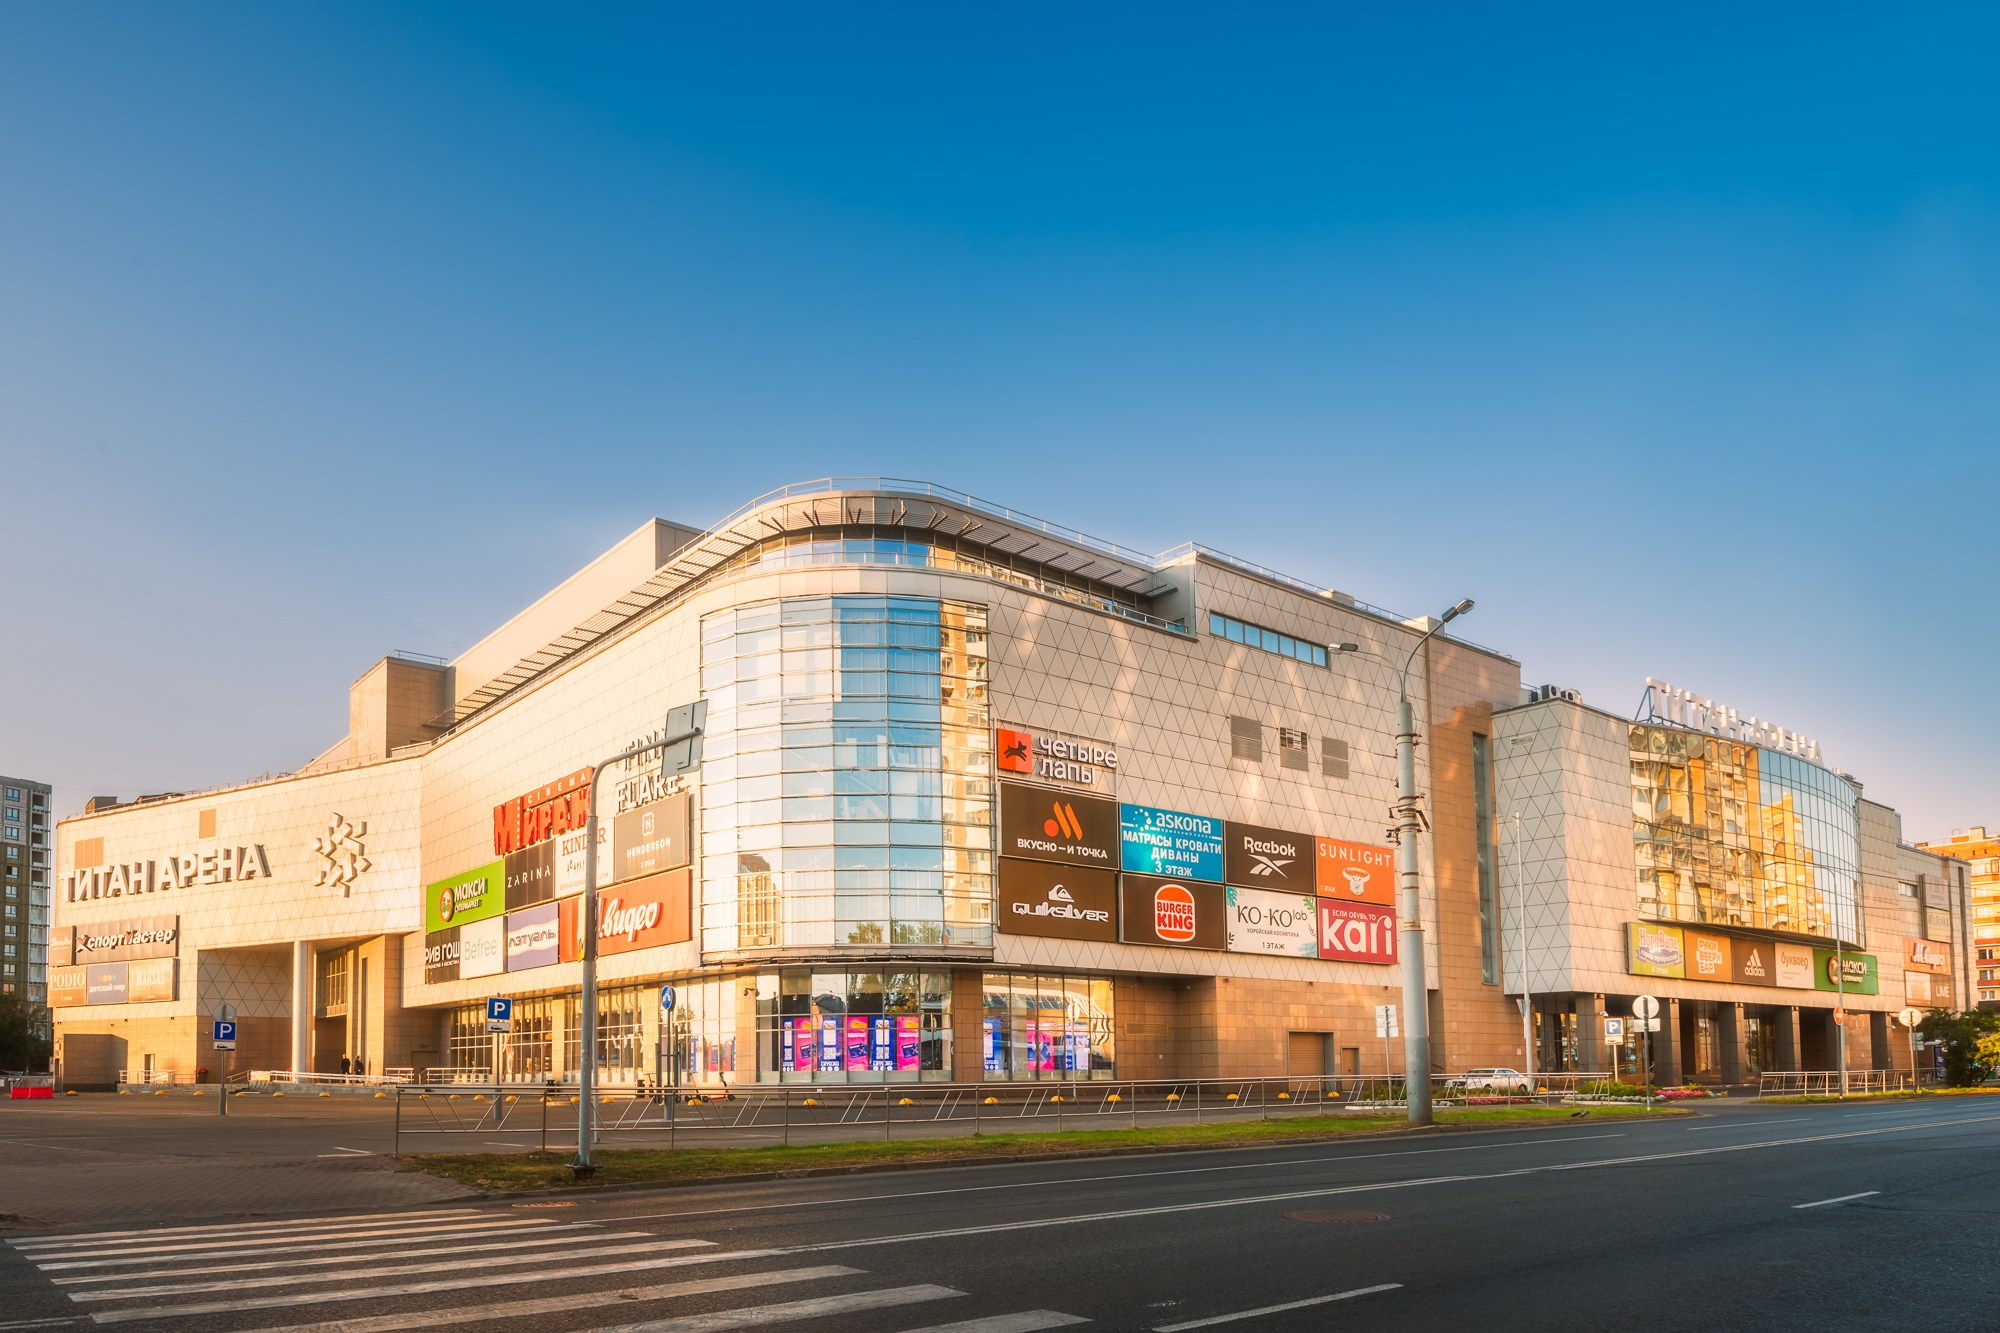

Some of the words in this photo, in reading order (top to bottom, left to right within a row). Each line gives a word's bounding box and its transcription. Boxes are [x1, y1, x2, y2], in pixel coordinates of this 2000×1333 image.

[1645, 677, 1740, 740] ТИТАН
[1749, 716, 1824, 767] АРЕНА
[528, 772, 586, 804] CINEMA
[1156, 812, 1211, 834] askona
[562, 827, 607, 857] KINDR
[627, 836, 671, 859] HENDERSON
[1017, 838, 1057, 853] ВКУСНО
[1067, 845, 1074, 855] И
[1076, 846, 1108, 859] ТОЧКА
[1123, 830, 1172, 848] МАТРАСЫ
[1175, 838, 1222, 855] КРОВАТИ
[1244, 836, 1296, 857] Reebok
[1151, 847, 1199, 864] ДИВАНЫ
[1319, 843, 1391, 867] SUNLIGHT
[58, 860, 155, 902] ТИТАН
[158, 844, 271, 891] АРЕНА
[507, 865, 551, 888] ZARINA
[1155, 861, 1162, 873] 3
[1165, 864, 1193, 877] этаж
[1156, 901, 1193, 915] BURGER
[1332, 909, 1348, 917] ЕСЛИ
[1348, 911, 1368, 920] ОБУВЬ,
[1157, 913, 1194, 930] KING
[1247, 928, 1273, 936] КОРЕЙСКАЯ
[1273, 930, 1300, 938] КОСМЕТИКА
[1322, 908, 1393, 955] kari
[442, 941, 460, 960] ГОШ
[464, 938, 498, 961] Befree
[1266, 942, 1285, 950] ЭТАЖ
[1698, 940, 1717, 951] РУКИ
[1699, 951, 1721, 962] ВВЕРХ
[1699, 963, 1714, 972] БАР
[1744, 966, 1765, 977] adidas
[49, 972, 85, 988] PODIO
[494, 1001, 506, 1016] P
[220, 1024, 232, 1038] P
[1608, 1021, 1619, 1033] P
